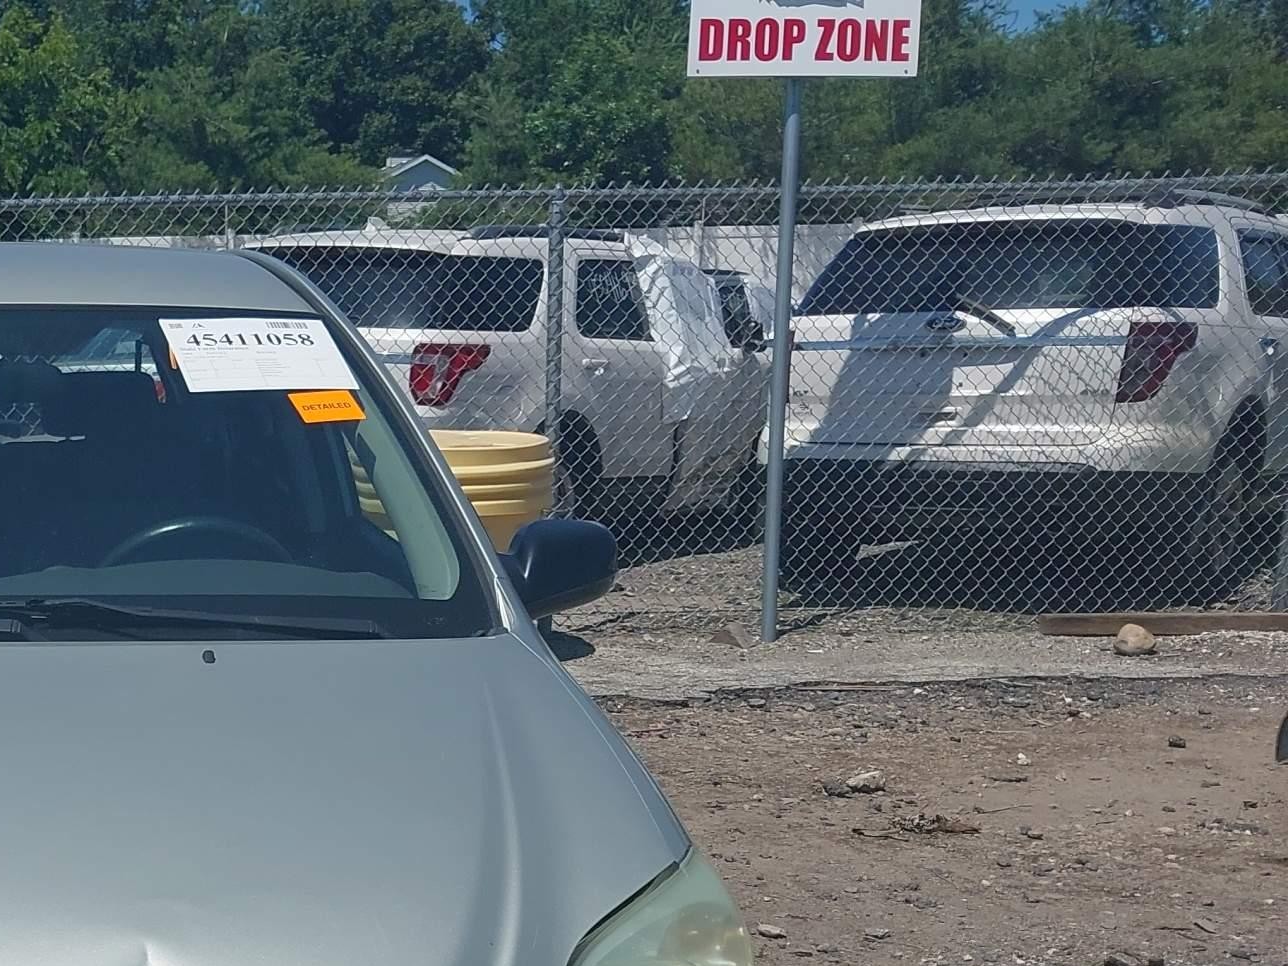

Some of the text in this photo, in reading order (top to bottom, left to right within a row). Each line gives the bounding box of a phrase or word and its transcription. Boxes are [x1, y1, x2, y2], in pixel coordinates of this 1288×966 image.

[698, 18, 911, 62] DROP ZONE
[186, 332, 315, 347] 45411058
[301, 402, 352, 411] DETAILED
